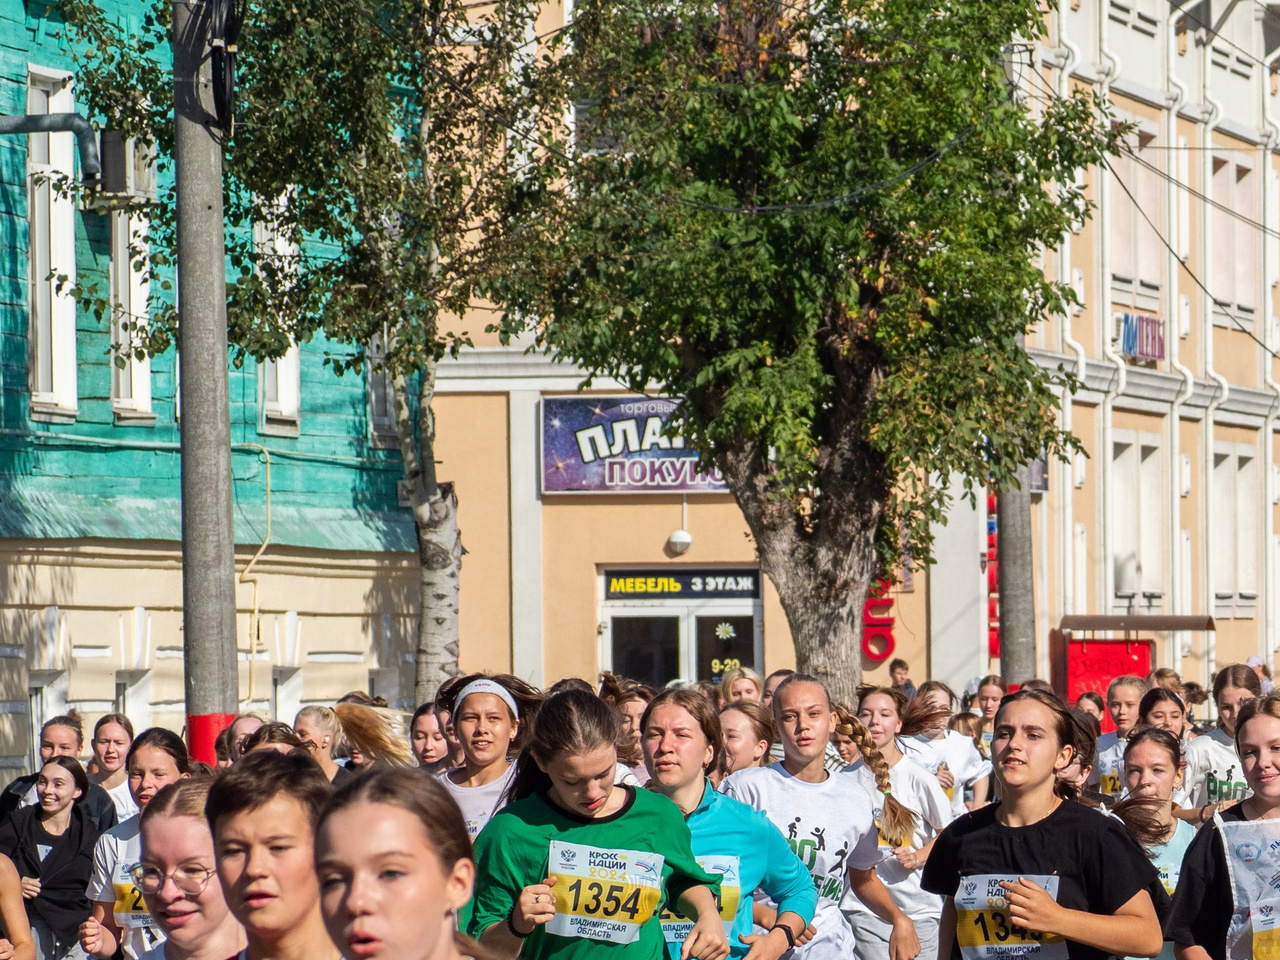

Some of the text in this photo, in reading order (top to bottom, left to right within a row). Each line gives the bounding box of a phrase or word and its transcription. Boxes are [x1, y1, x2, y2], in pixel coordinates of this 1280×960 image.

[610, 577, 682, 593] МЕБЕЛЬ
[705, 576, 754, 591] ЭТАЖ
[589, 851, 618, 860] КРОСС
[588, 859, 627, 870] НАЦИИ
[588, 867, 627, 881] 2024
[568, 879, 641, 920] 1354
[570, 918, 627, 932] ВЛАДИМИРСКАЯ
[577, 927, 611, 939] ОБЛАСТЬ
[986, 946, 1041, 955] ВЛАДИМИРСКАЯ
